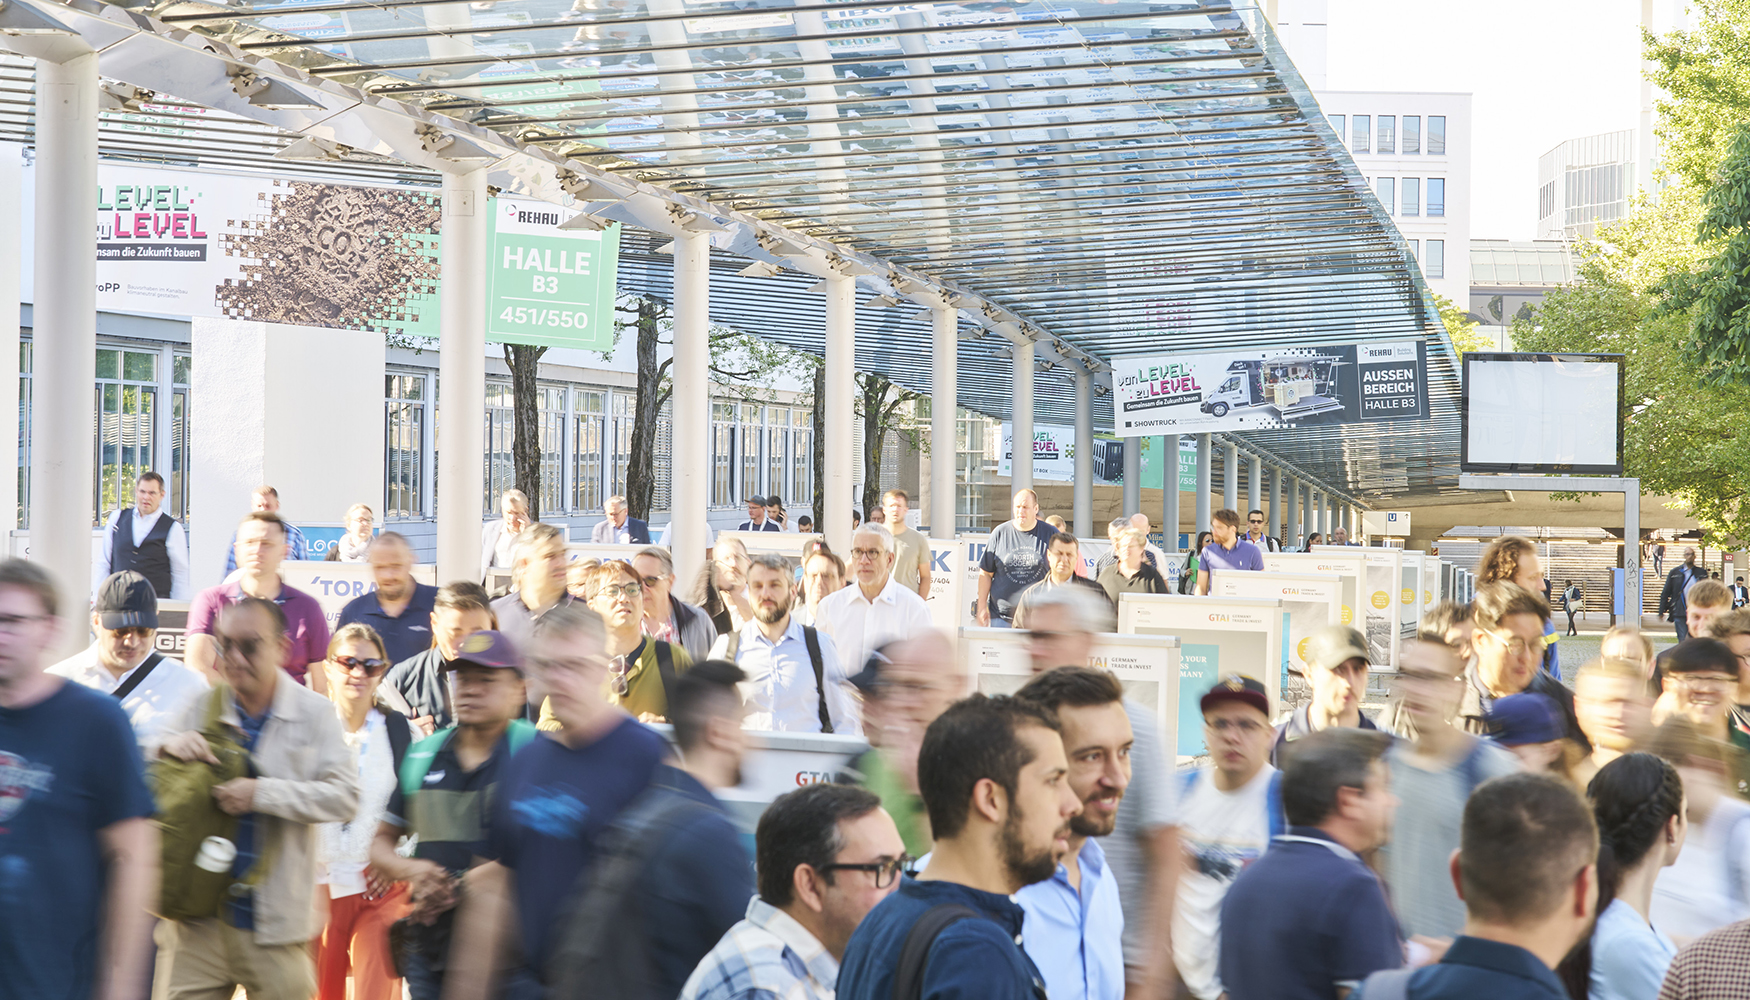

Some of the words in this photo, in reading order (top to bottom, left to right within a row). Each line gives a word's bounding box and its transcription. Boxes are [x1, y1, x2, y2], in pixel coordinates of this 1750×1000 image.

[97, 185, 190, 211] LEVEL
[518, 210, 559, 226] REHAU
[114, 213, 207, 239] LEVEL
[97, 247, 121, 257] nsam
[122, 247, 136, 257] die
[137, 247, 172, 257] Zukunft
[174, 248, 201, 258] bauen
[503, 246, 592, 276] HALLE
[97, 283, 120, 292] oPP
[532, 275, 559, 294] B3
[500, 306, 589, 329] 451/550
[1369, 349, 1393, 357] REHAU
[1117, 375, 1138, 387] von
[1138, 362, 1190, 383] LEVEL
[1363, 369, 1414, 382] AUSSEN
[1150, 376, 1202, 396] LEVEL
[1364, 382, 1415, 395] BEREICH
[1126, 401, 1155, 410] Gemeinsam
[1164, 397, 1183, 405] Zukunft
[1365, 399, 1400, 410] HALLE
[1401, 398, 1416, 408] B3
[1134, 418, 1177, 427] SHOWTRUCK
[1033, 431, 1053, 441] VEL
[1033, 442, 1059, 451] EVEL
[306, 539, 338, 552] LOC
[320, 580, 379, 597] TORA
[1282, 587, 1299, 595] GTAI
[1208, 613, 1230, 622] GTAI
[1087, 656, 1107, 667] TAI
[1185, 655, 1207, 663] YOUR
[796, 771, 831, 787] GTA
